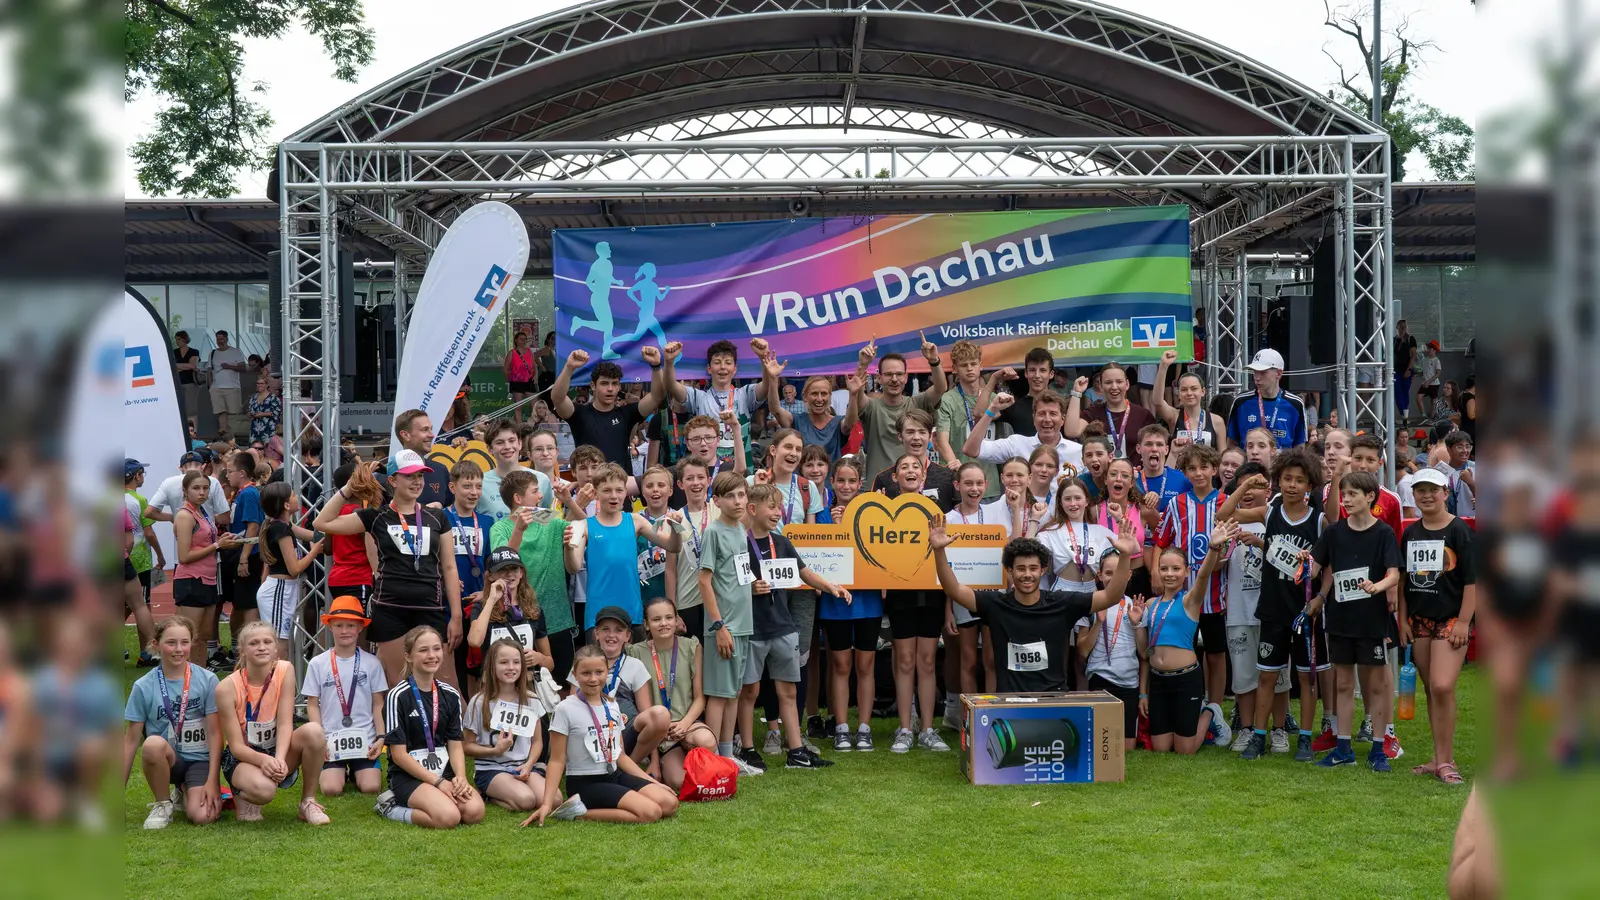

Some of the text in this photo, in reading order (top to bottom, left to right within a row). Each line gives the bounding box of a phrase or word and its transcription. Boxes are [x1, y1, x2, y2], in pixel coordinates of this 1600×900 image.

[736, 233, 1055, 335] VRun Dachau
[940, 321, 1123, 338] Volksbank Raiffeisenbank
[428, 309, 476, 389] Raiffeisenbank
[1047, 336, 1123, 351] Dachau eG
[450, 335, 476, 376] Dachau
[786, 532, 850, 541] Gewinnen mit
[869, 525, 921, 544] Herz
[1413, 549, 1436, 562] 1914
[769, 567, 793, 580] 1949
[1015, 651, 1041, 663] 1958
[500, 710, 529, 728] 1910
[257, 730, 277, 742] 197
[334, 737, 363, 751] 1989
[593, 736, 616, 752] 141
[1024, 746, 1038, 782] LIVE
[1038, 746, 1051, 781] LIFE
[1051, 739, 1065, 781] LOUD
[697, 784, 726, 795] Team
